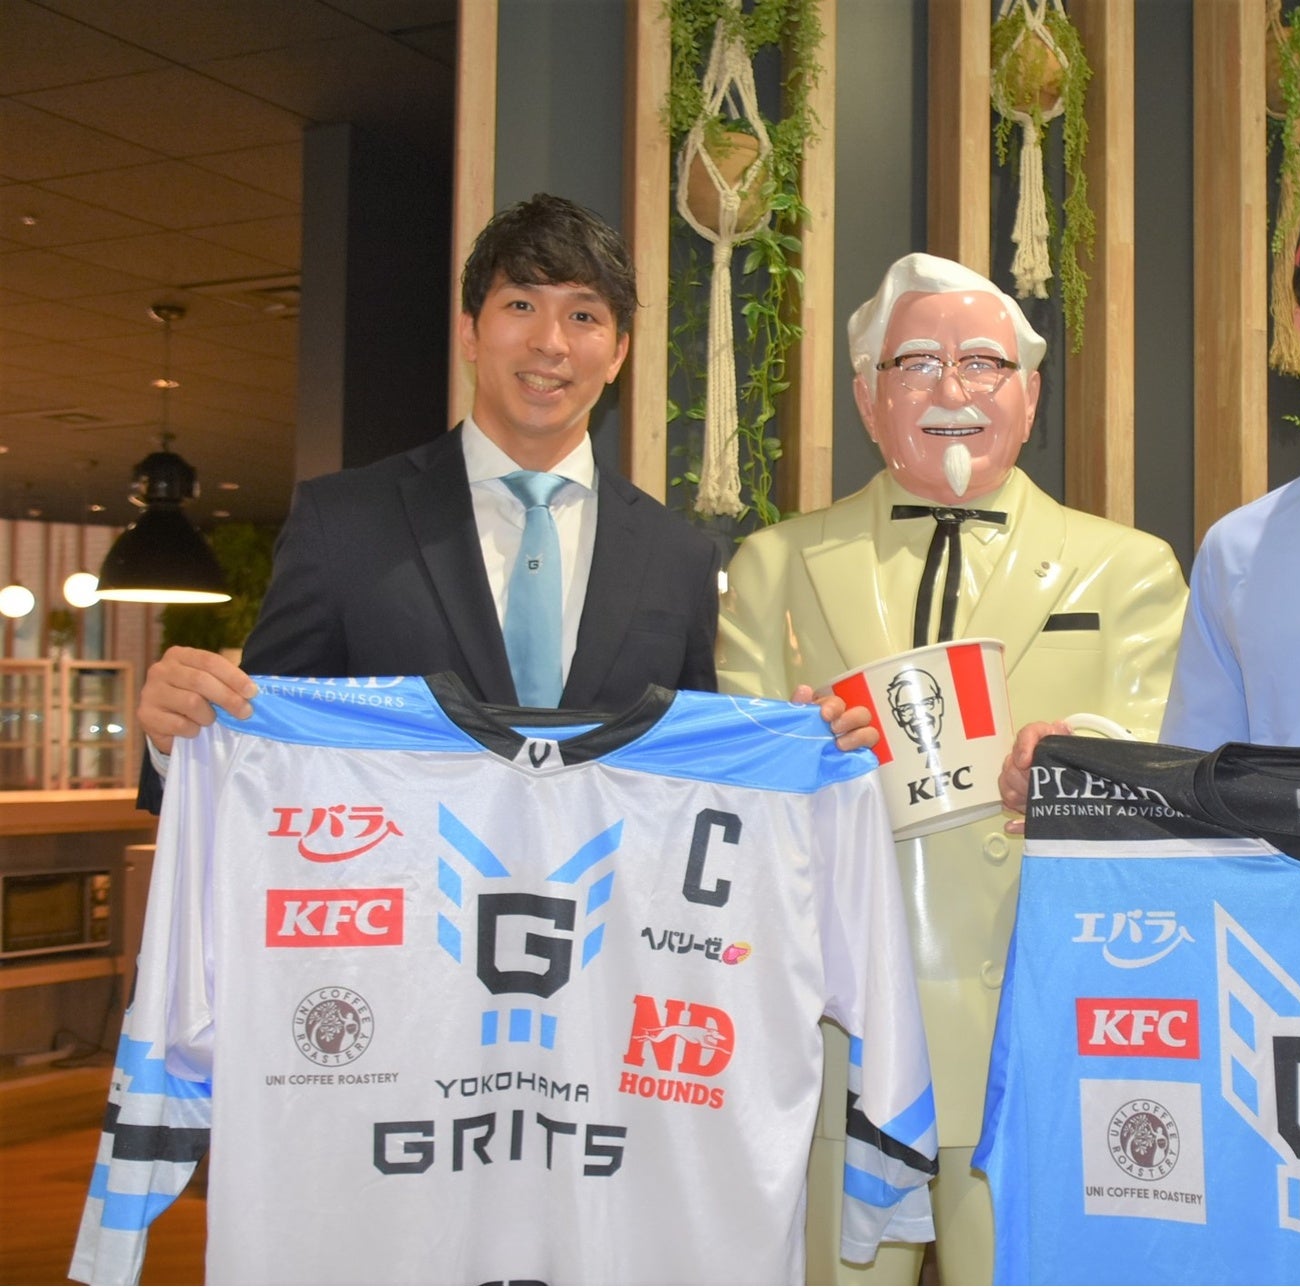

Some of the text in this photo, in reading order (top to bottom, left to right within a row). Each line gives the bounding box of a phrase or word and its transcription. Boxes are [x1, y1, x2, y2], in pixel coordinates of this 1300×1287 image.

[528, 560, 539, 570] G
[312, 689, 405, 708] ADVISORS
[907, 765, 973, 805] KFC
[268, 805, 404, 850] エバラ
[1032, 804, 1113, 818] INVESTMENT
[682, 808, 743, 907] C
[277, 899, 391, 937] KFC
[1071, 911, 1195, 952] エバラ
[475, 893, 577, 999] G
[641, 927, 723, 962] ヘパリーゼ
[296, 989, 371, 1025] UNI COFFEE
[624, 995, 735, 1077] ND
[1089, 1008, 1190, 1047] KFC
[297, 1032, 369, 1063] ROASTERY
[266, 1073, 399, 1086] UNI COFFEE ROASTERY
[435, 1071, 590, 1103] YOKOHAMA
[618, 1072, 725, 1109] HOUNDS
[1111, 1102, 1177, 1139] UNI COFFEE
[372, 1109, 628, 1177] GRITS
[1112, 1146, 1177, 1178] ROASTERY
[1086, 1186, 1203, 1205] UNI COFFEE ROASTERY
